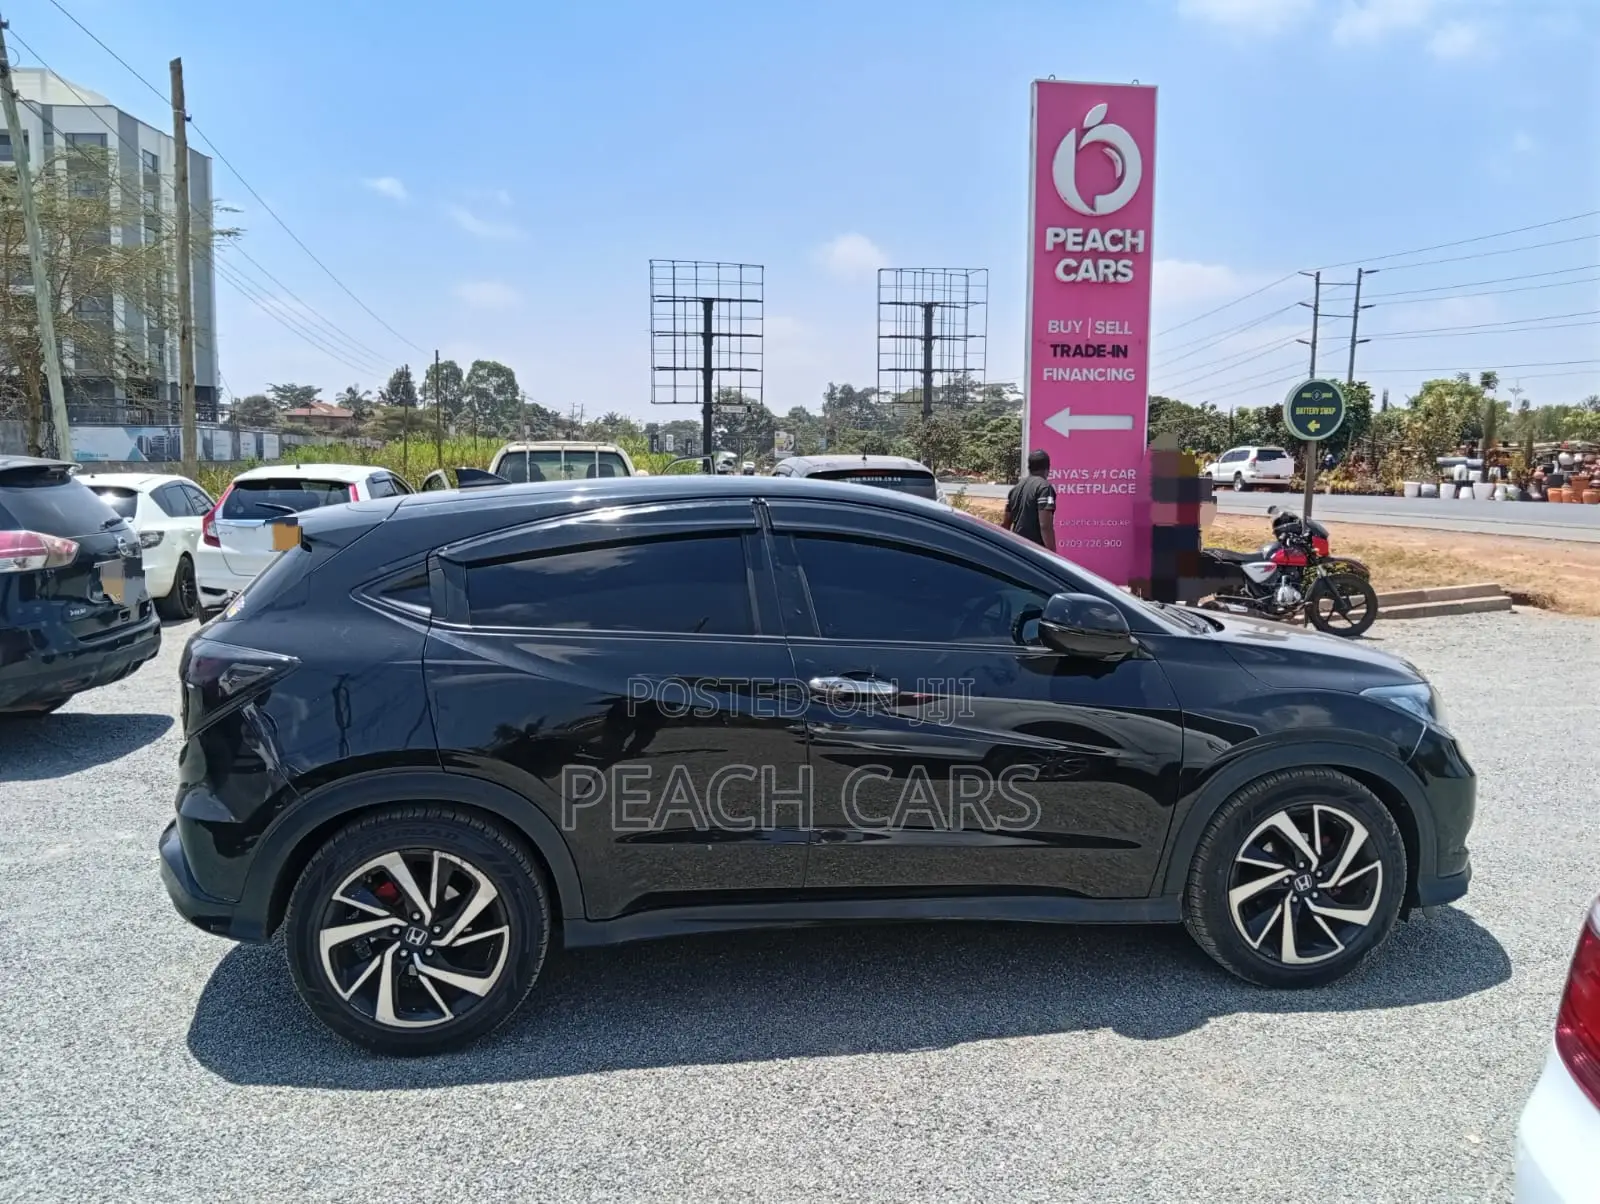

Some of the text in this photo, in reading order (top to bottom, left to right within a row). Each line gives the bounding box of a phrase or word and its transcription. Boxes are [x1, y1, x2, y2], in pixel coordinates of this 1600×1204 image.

[1045, 227, 1145, 253] PEACH
[1054, 258, 1134, 283] CARS
[1047, 320, 1133, 335] BUY SELL
[1050, 344, 1128, 359] TRADE-IN
[1043, 367, 1136, 382] FINANCING
[1047, 469, 1137, 480] ENYA'S #1 CAR
